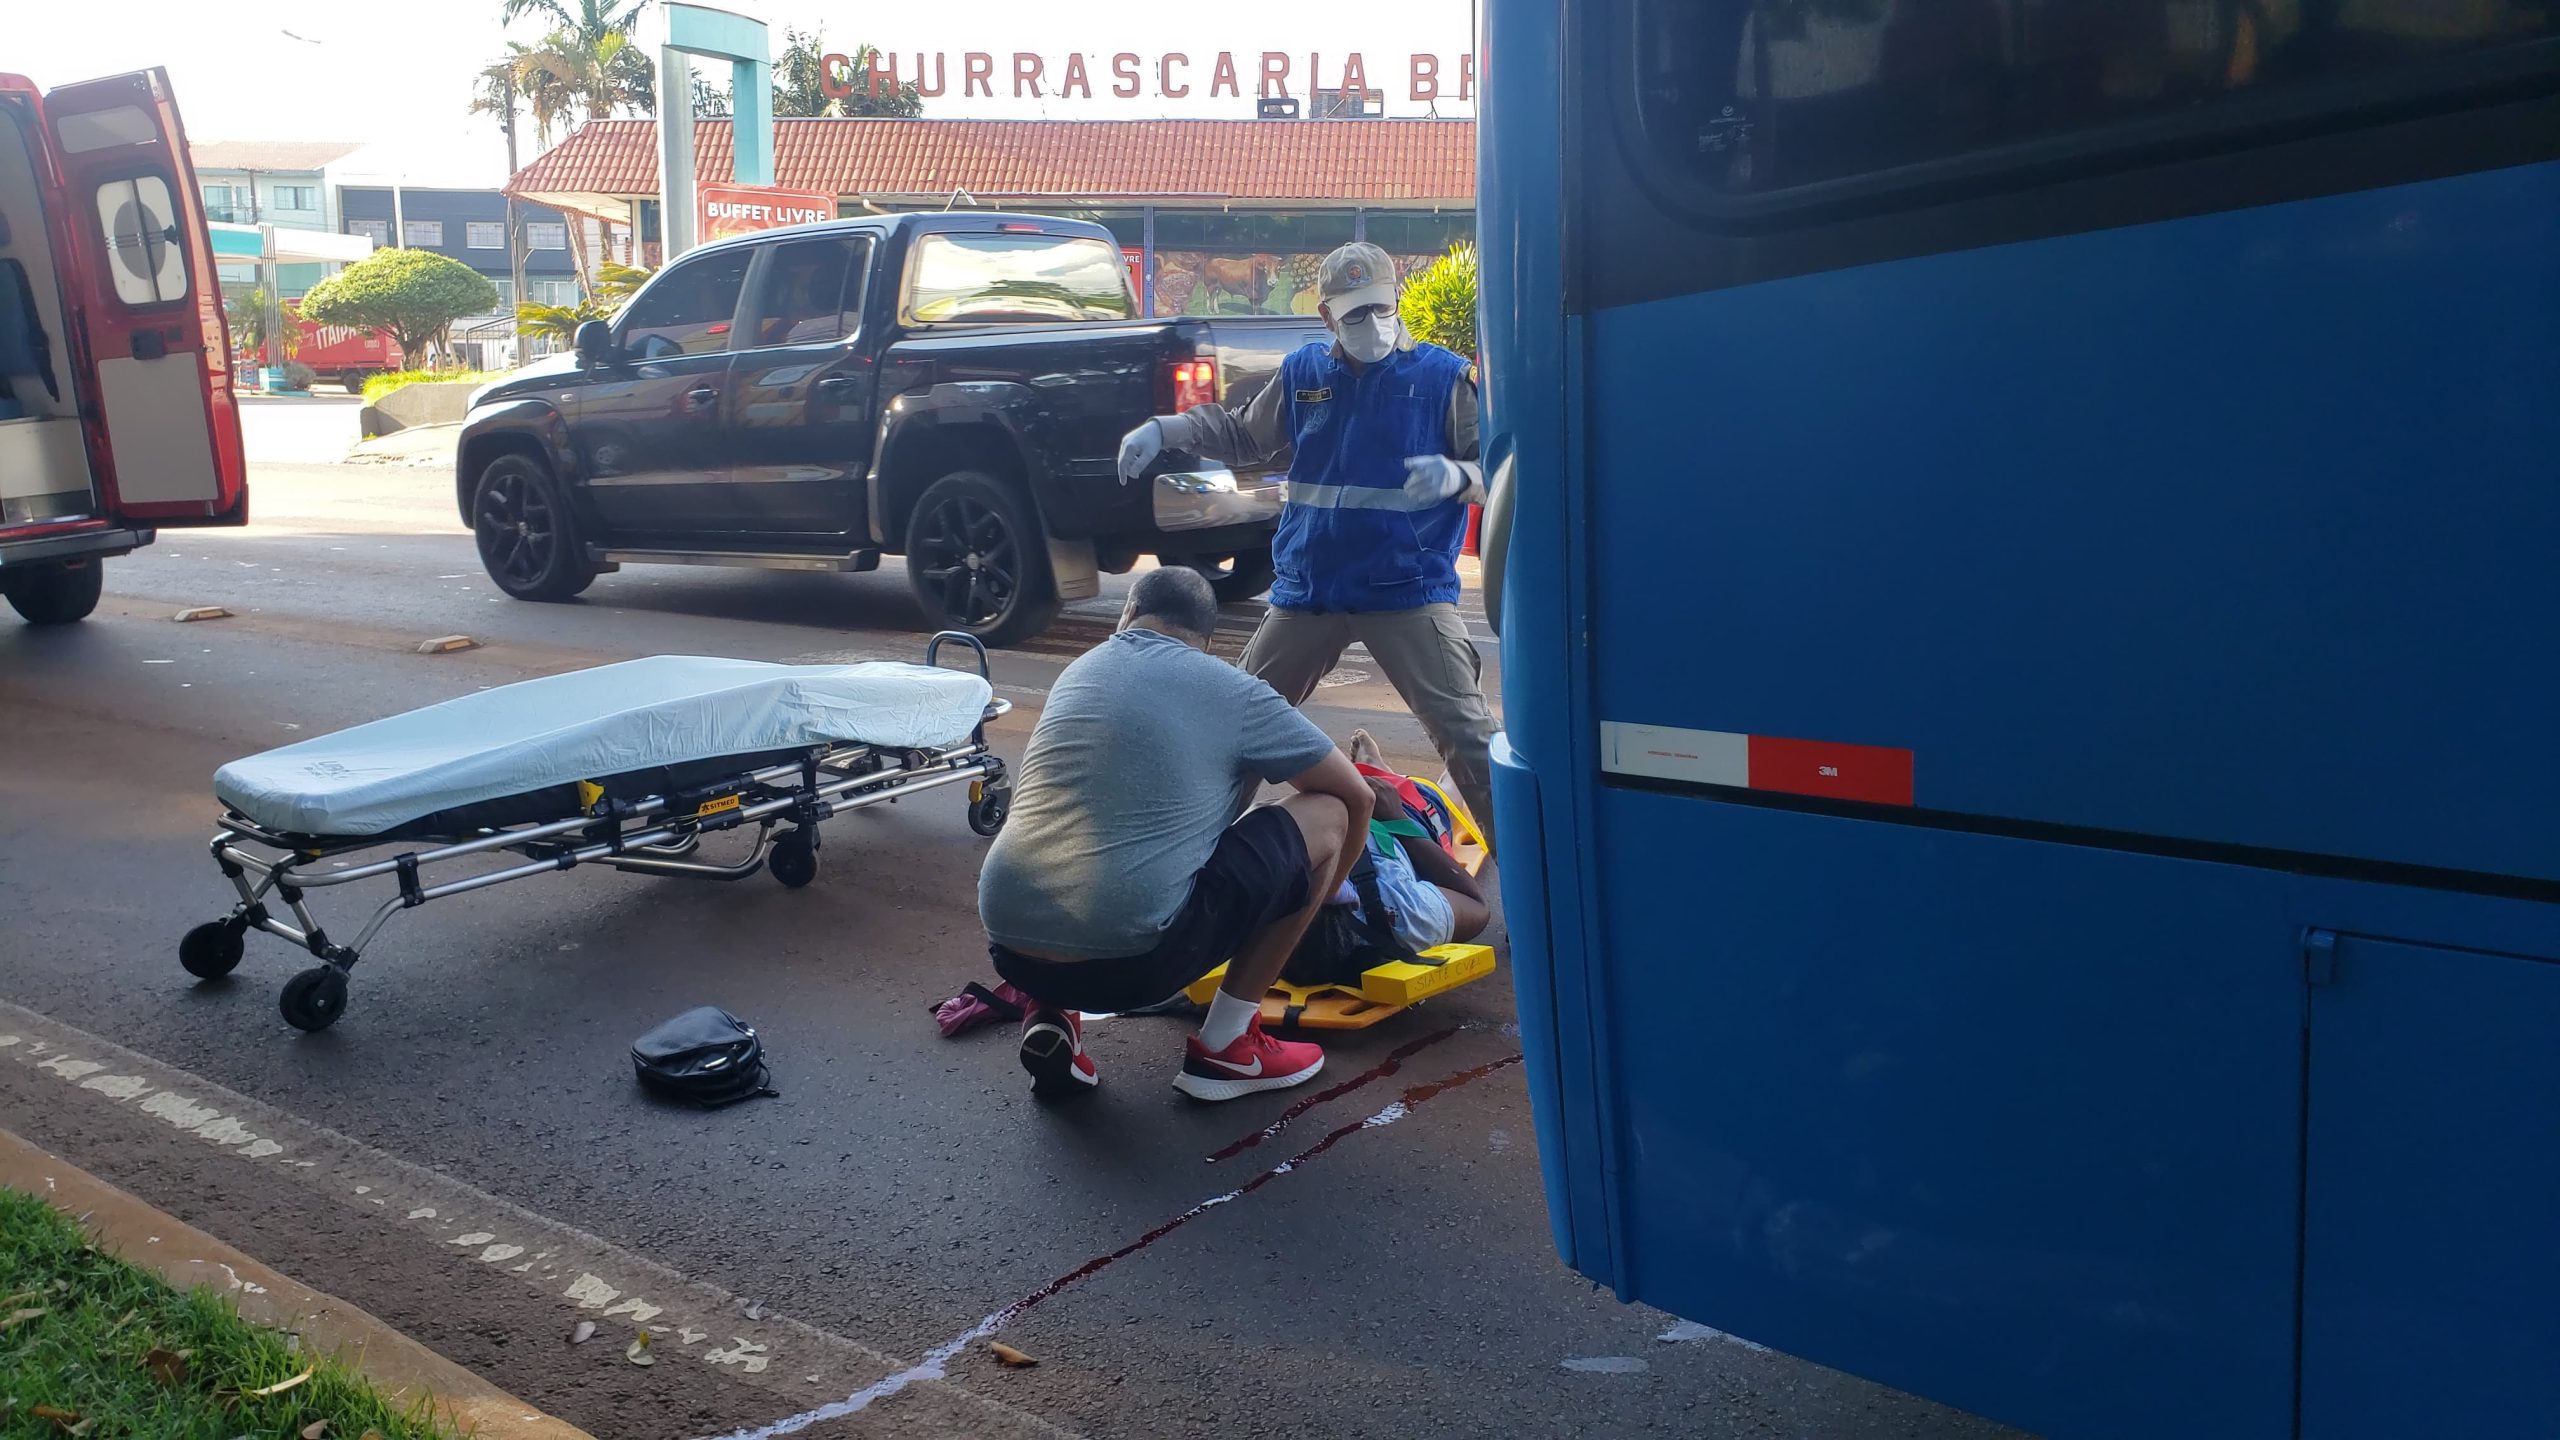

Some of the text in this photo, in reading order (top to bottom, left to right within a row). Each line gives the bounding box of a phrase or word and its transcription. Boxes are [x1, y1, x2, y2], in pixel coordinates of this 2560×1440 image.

[820, 52, 1371, 99] CHURRASCARIA
[707, 202, 826, 223] BUFFET LIVRE
[1818, 765, 1838, 777] 3M
[709, 797, 735, 810] SITMED
